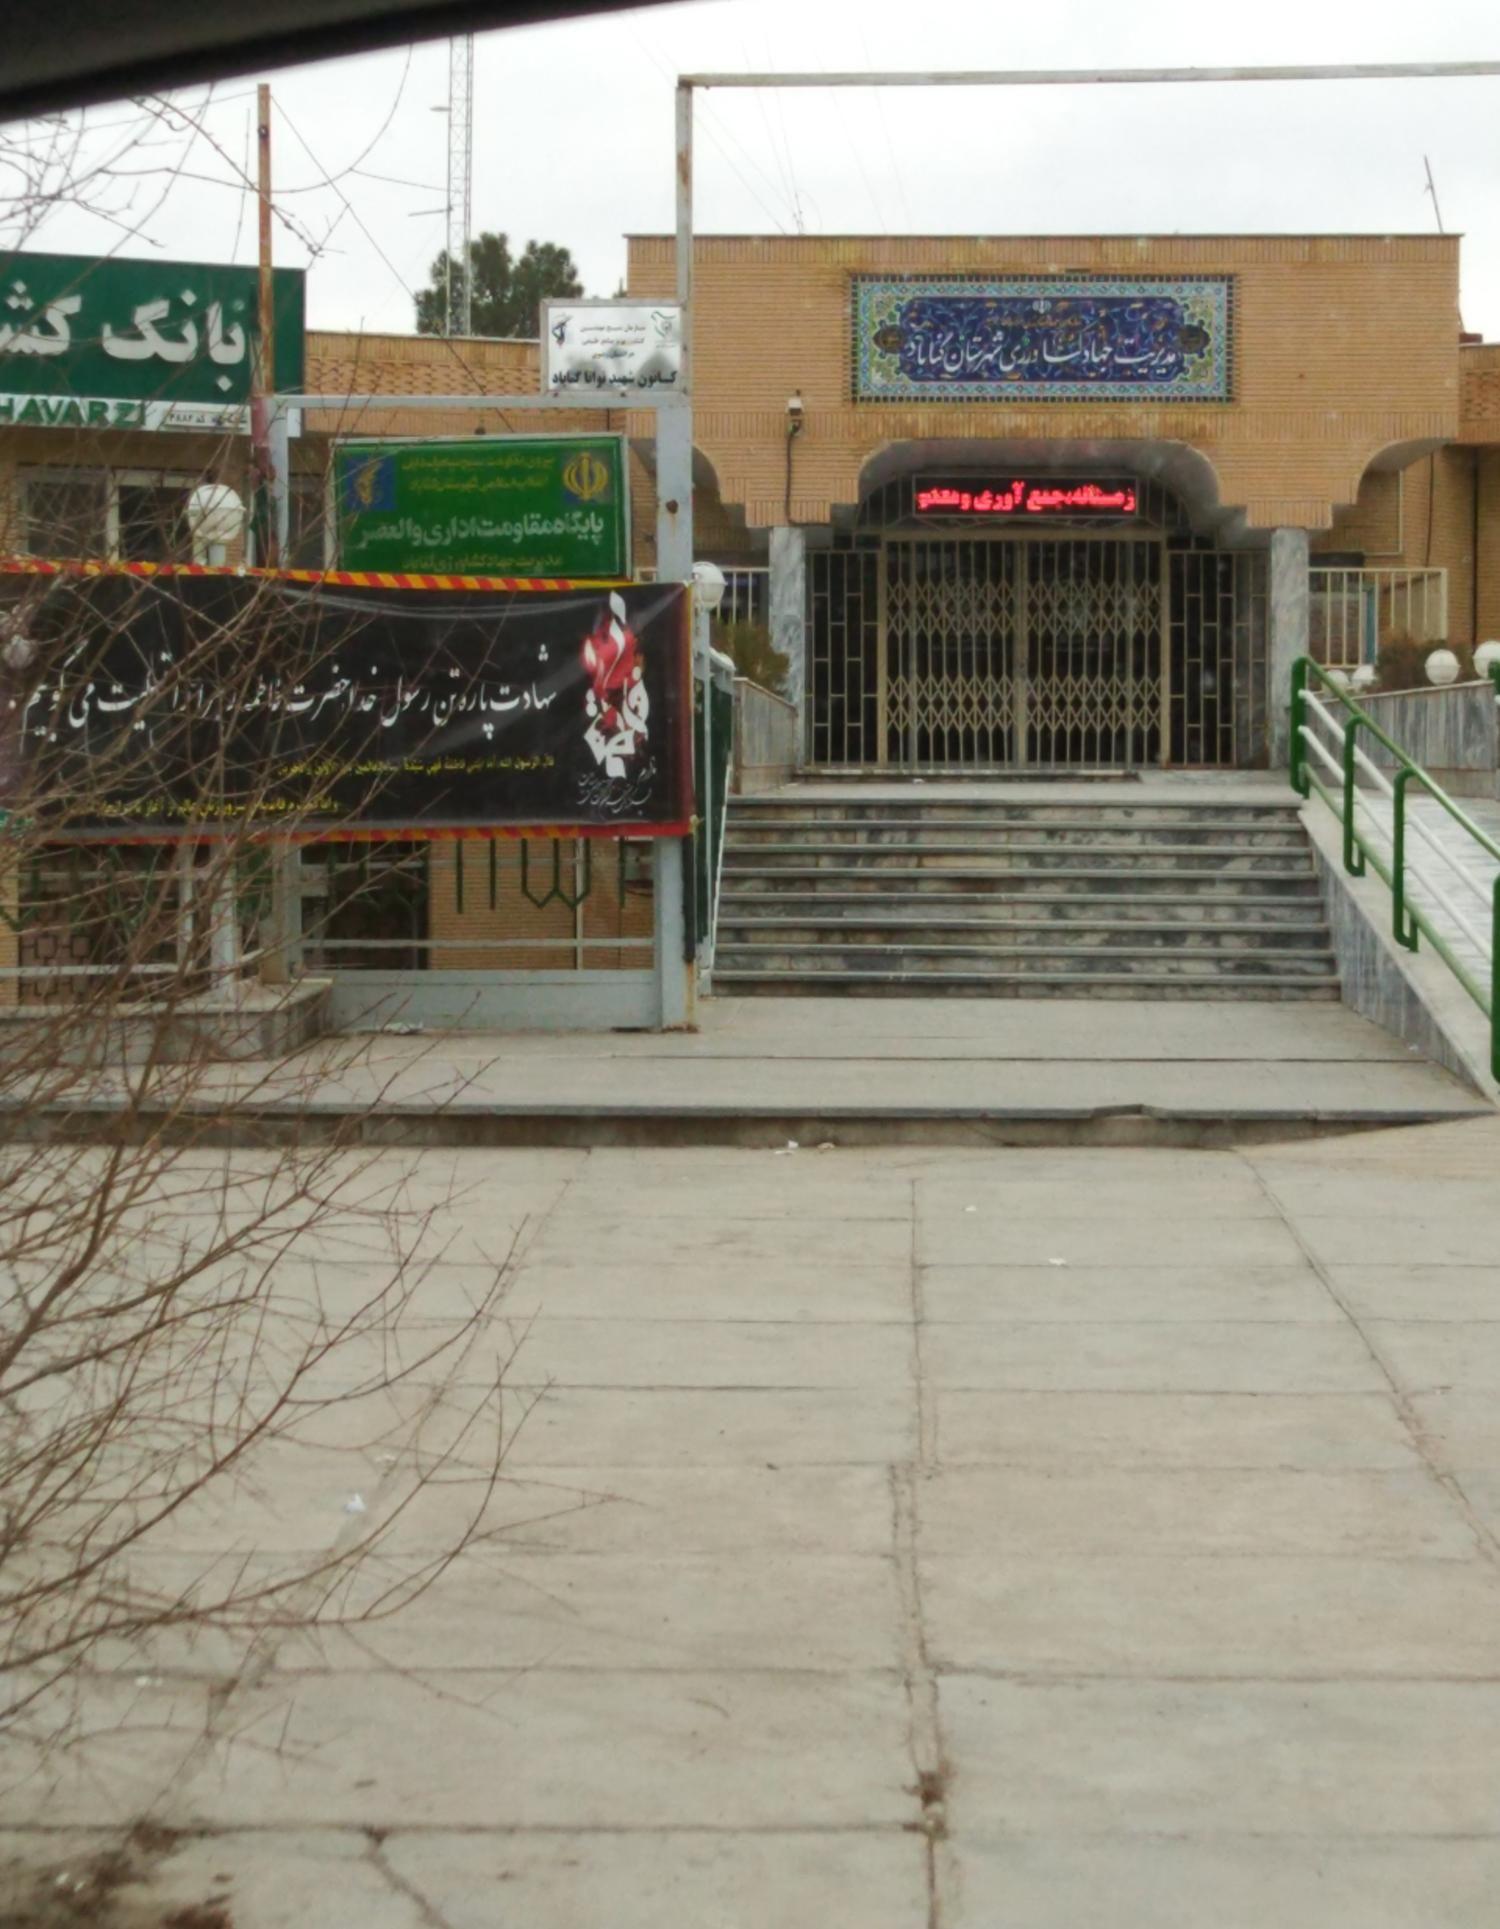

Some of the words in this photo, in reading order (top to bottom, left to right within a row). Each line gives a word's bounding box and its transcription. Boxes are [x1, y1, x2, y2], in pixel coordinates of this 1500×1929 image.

[102, 287, 246, 392] بانک
[380, 675, 431, 728] رسول
[489, 643, 557, 712] شهادت
